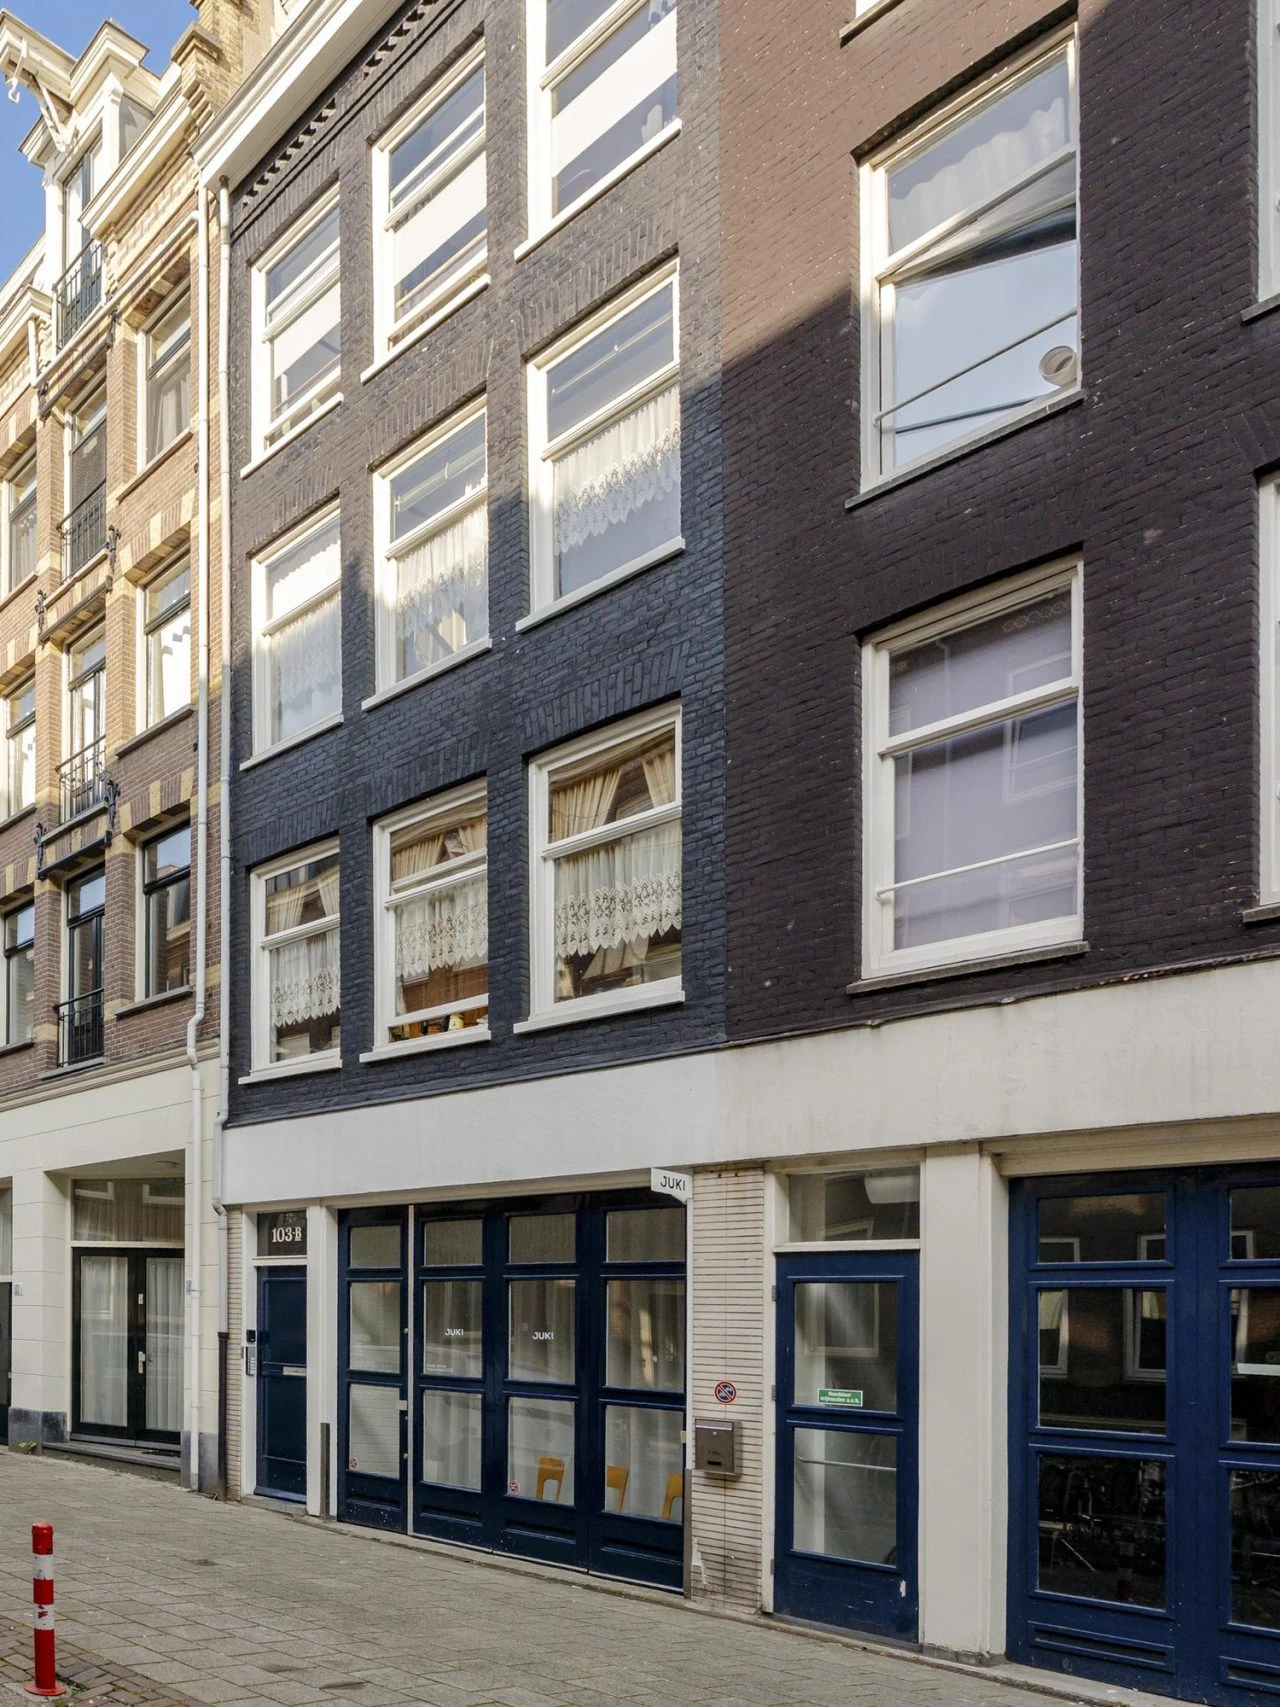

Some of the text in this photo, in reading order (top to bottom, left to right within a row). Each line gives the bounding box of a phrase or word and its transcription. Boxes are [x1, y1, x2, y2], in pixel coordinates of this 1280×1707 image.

[660, 1175, 686, 1191] JUKI
[444, 1328, 464, 1336] JUKI
[532, 1331, 554, 1340] JUKI
